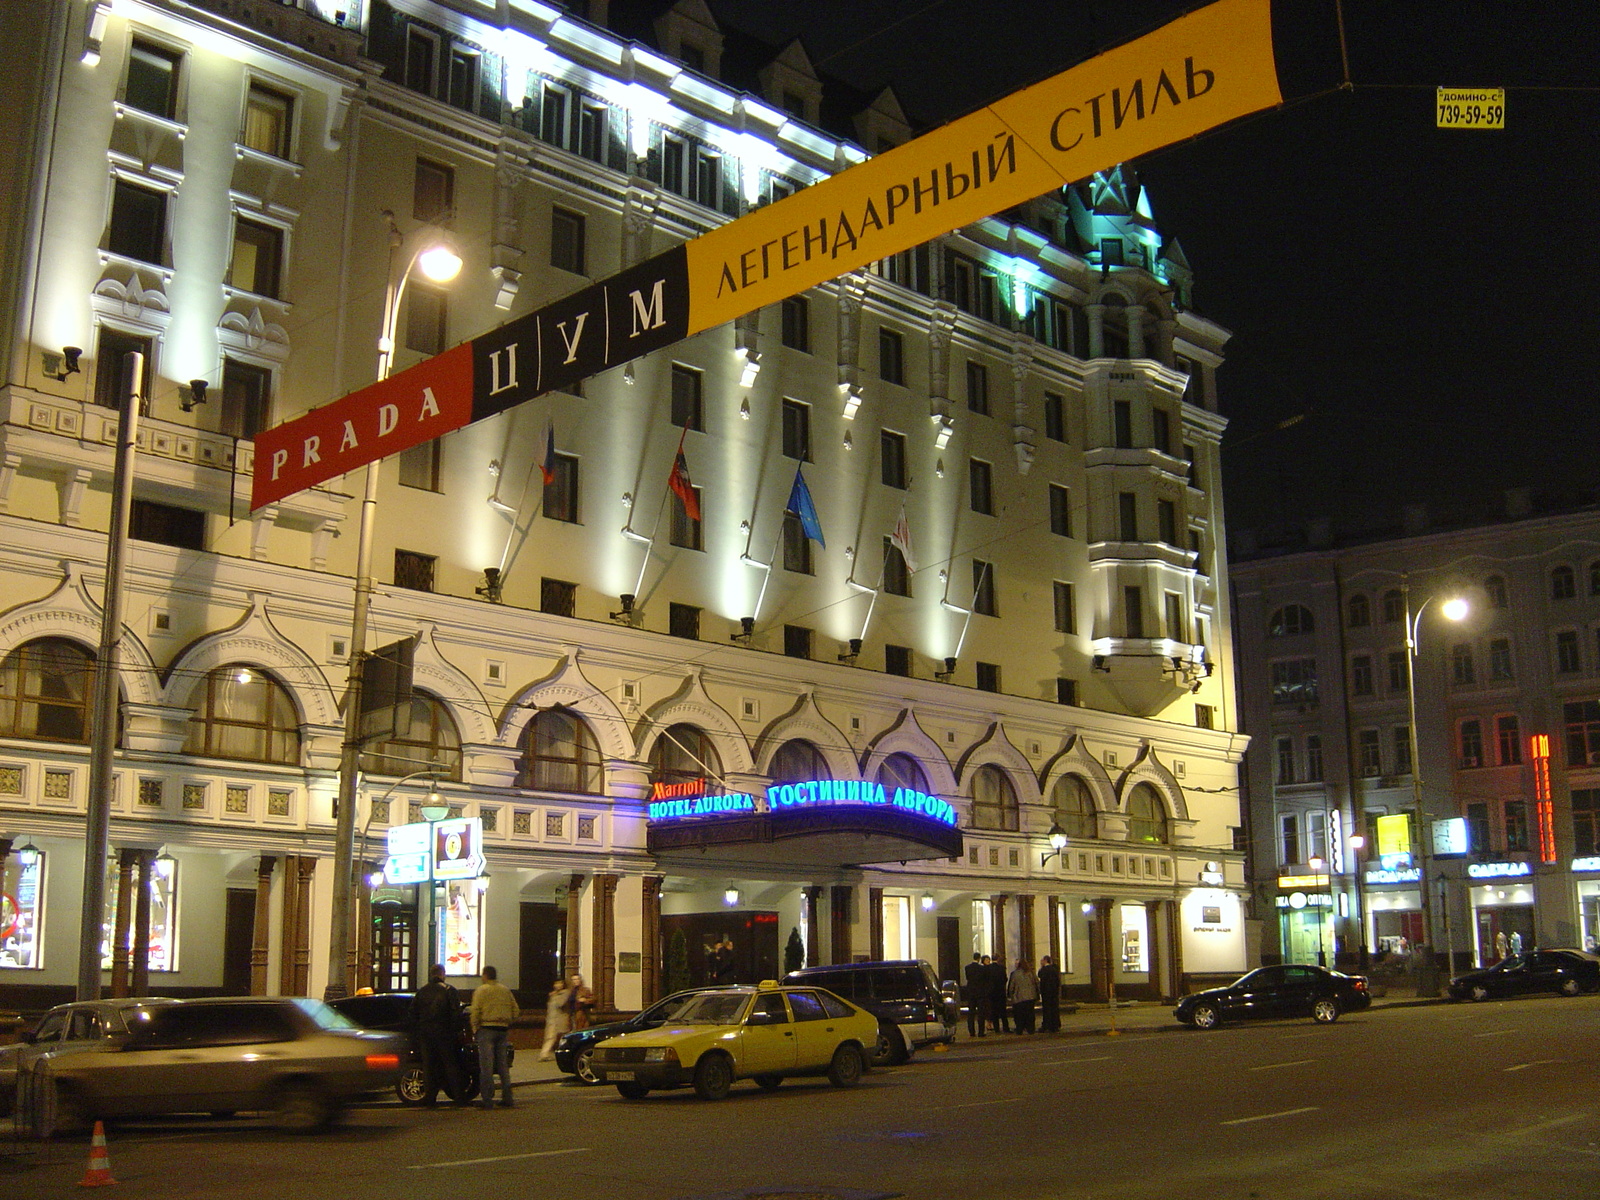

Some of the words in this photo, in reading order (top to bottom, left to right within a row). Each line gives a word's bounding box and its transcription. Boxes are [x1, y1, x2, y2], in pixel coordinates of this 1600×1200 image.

[1440, 105, 1503, 124] 739-59-59
[717, 132, 1017, 299] ЛЕГЕНДАРНЫЙ
[1049, 56, 1215, 152] СТИЛЬ
[271, 387, 440, 481] PRADA
[649, 799, 692, 819] HOTEL
[693, 794, 754, 814] AURORA
[650, 778, 706, 801] Marriott
[767, 779, 886, 809] ГОСТИНИЦА
[892, 787, 956, 826] АВРОРА
